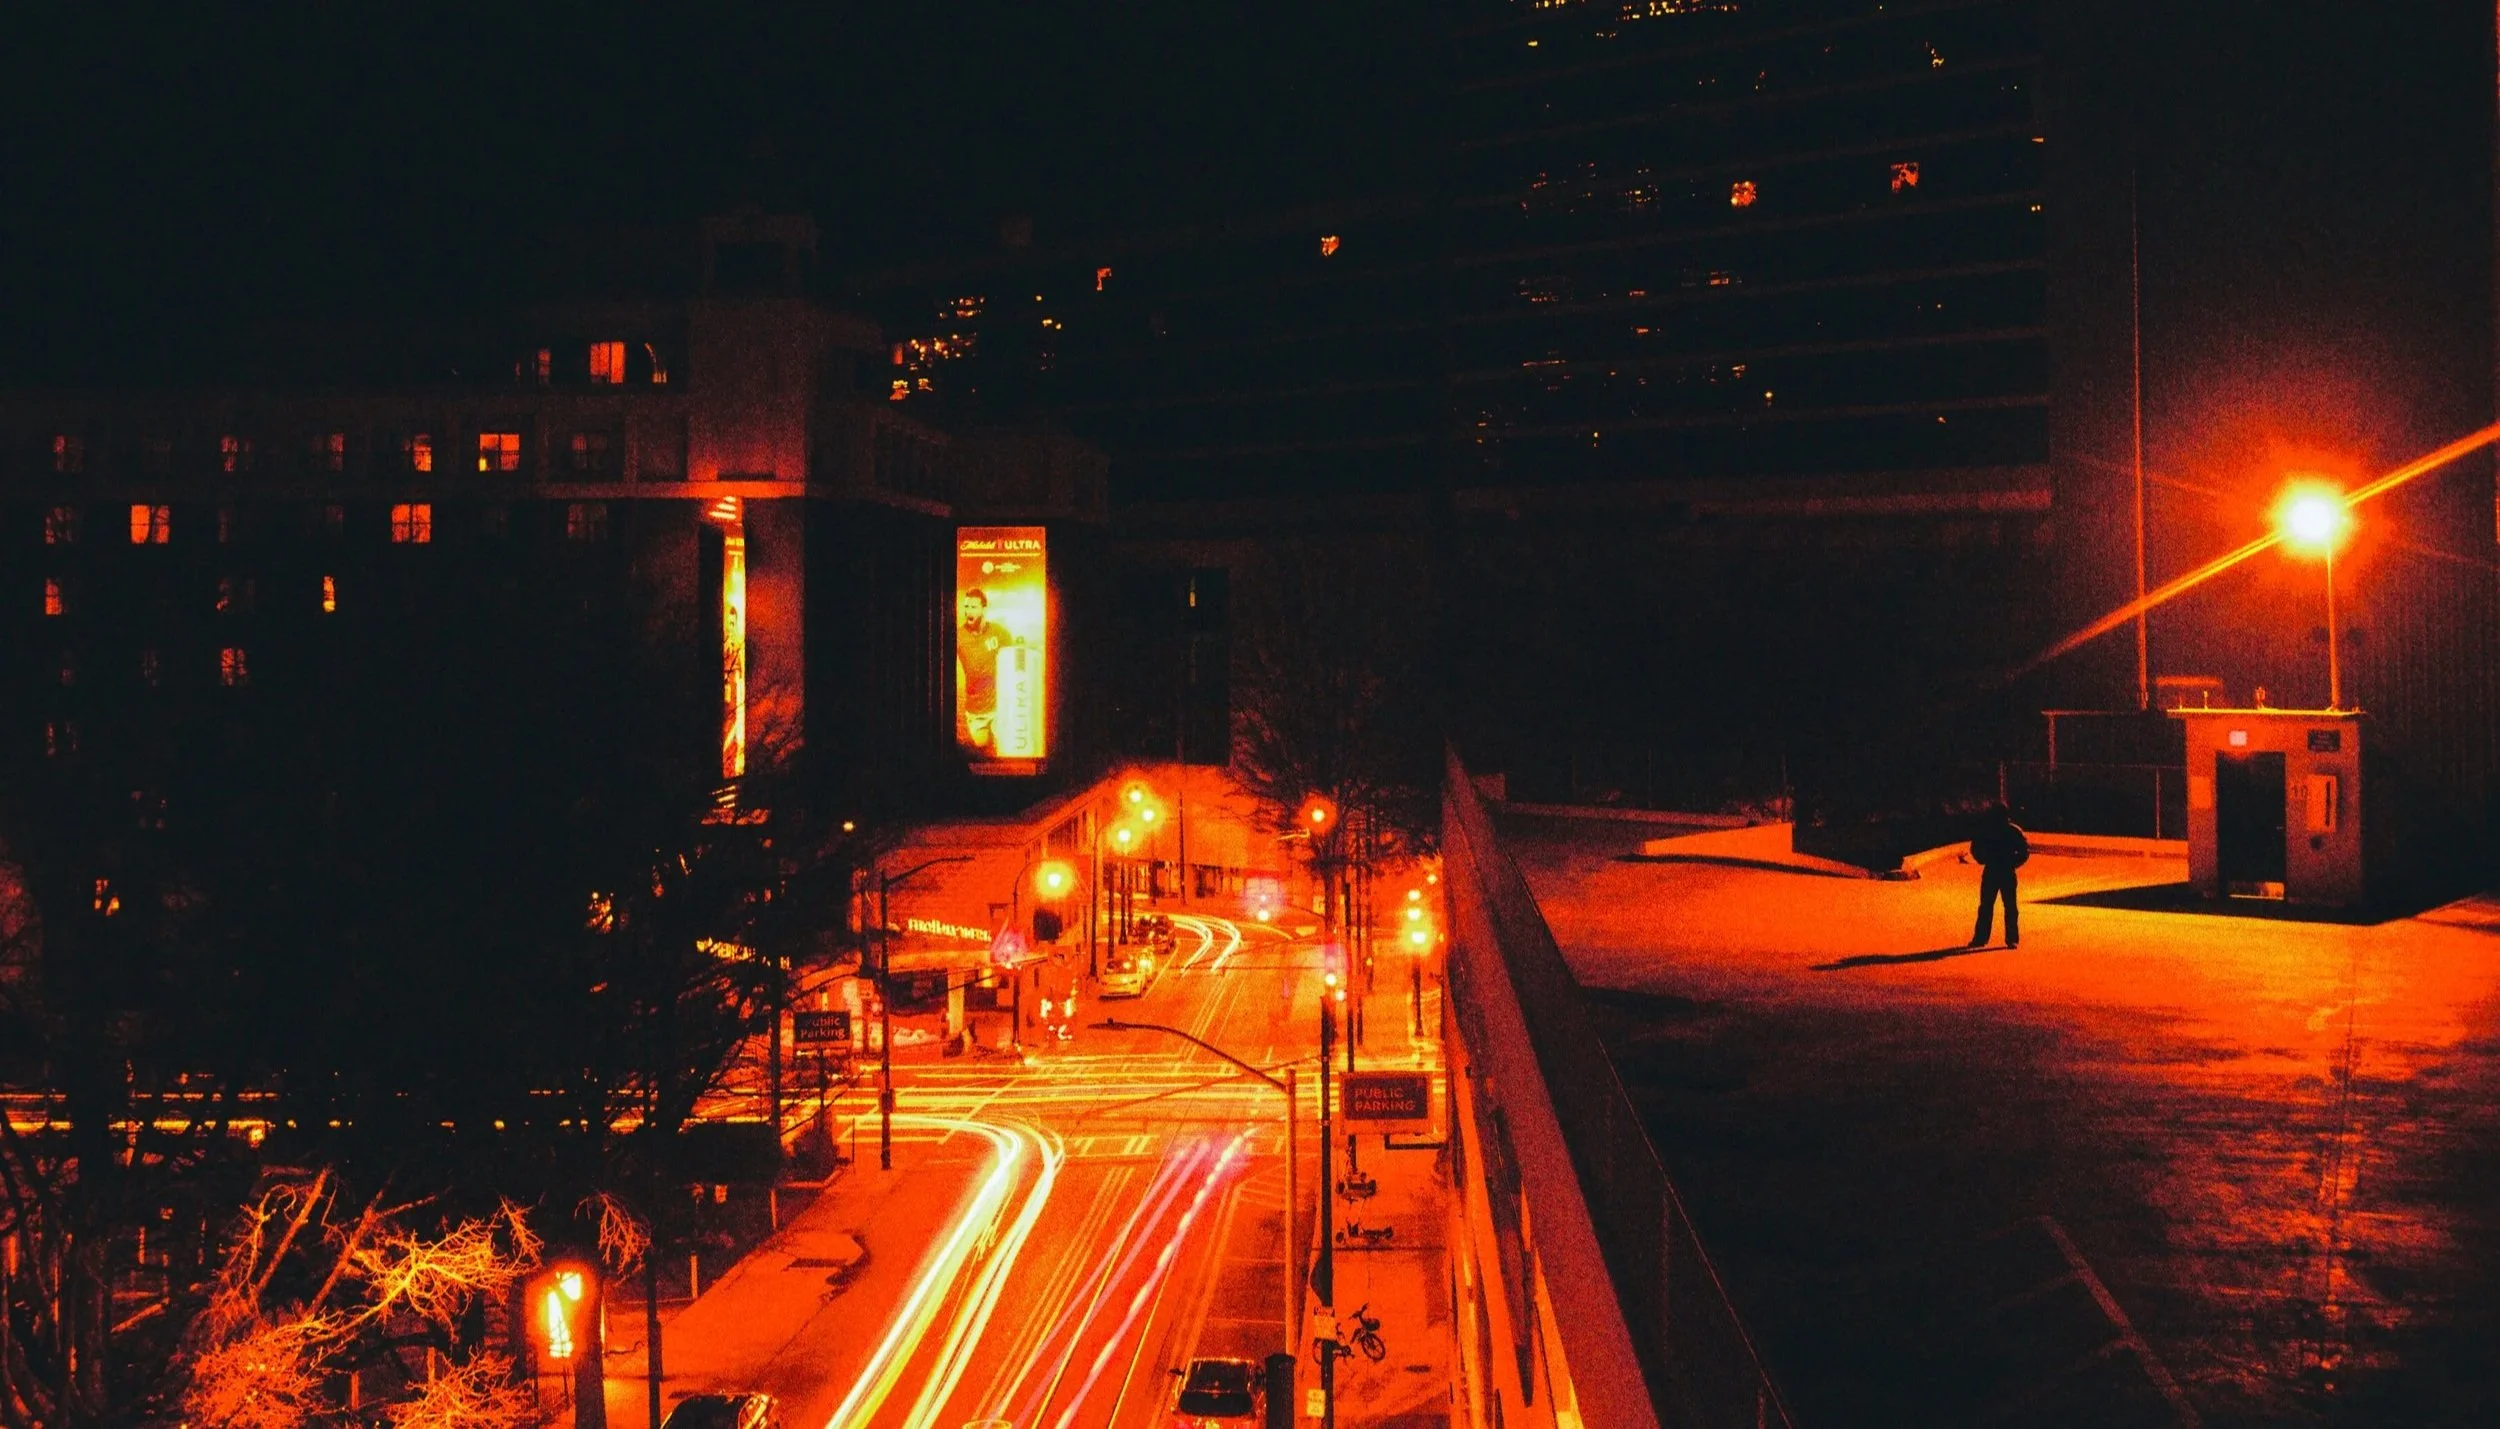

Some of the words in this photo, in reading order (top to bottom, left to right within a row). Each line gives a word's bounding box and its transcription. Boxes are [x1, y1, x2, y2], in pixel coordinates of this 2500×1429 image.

[1004, 540, 1041, 550] ULTRA
[1355, 1087, 1404, 1099] PUBLIC
[1355, 1100, 1416, 1112] PARKING
